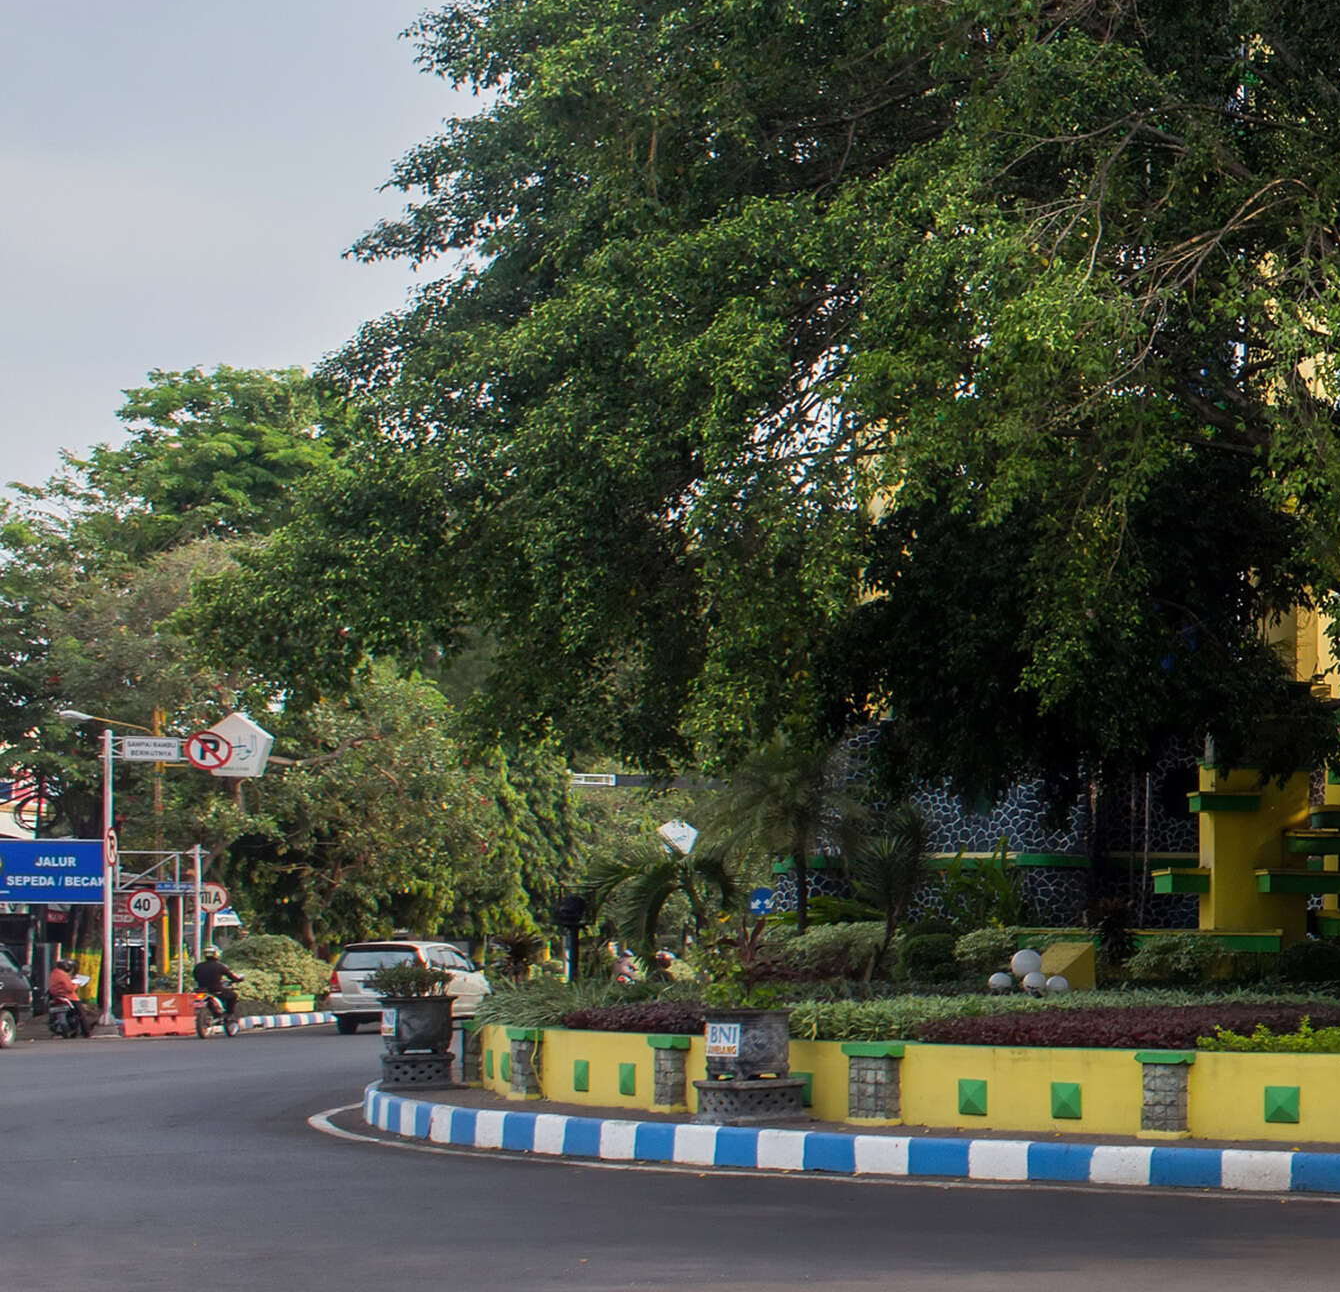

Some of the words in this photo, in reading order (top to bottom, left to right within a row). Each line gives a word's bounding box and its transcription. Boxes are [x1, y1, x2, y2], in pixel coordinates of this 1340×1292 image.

[35, 856, 77, 867] JALUR
[6, 875, 56, 887] SEPEDA
[133, 898, 151, 912] 40
[709, 1026, 738, 1045] BNI
